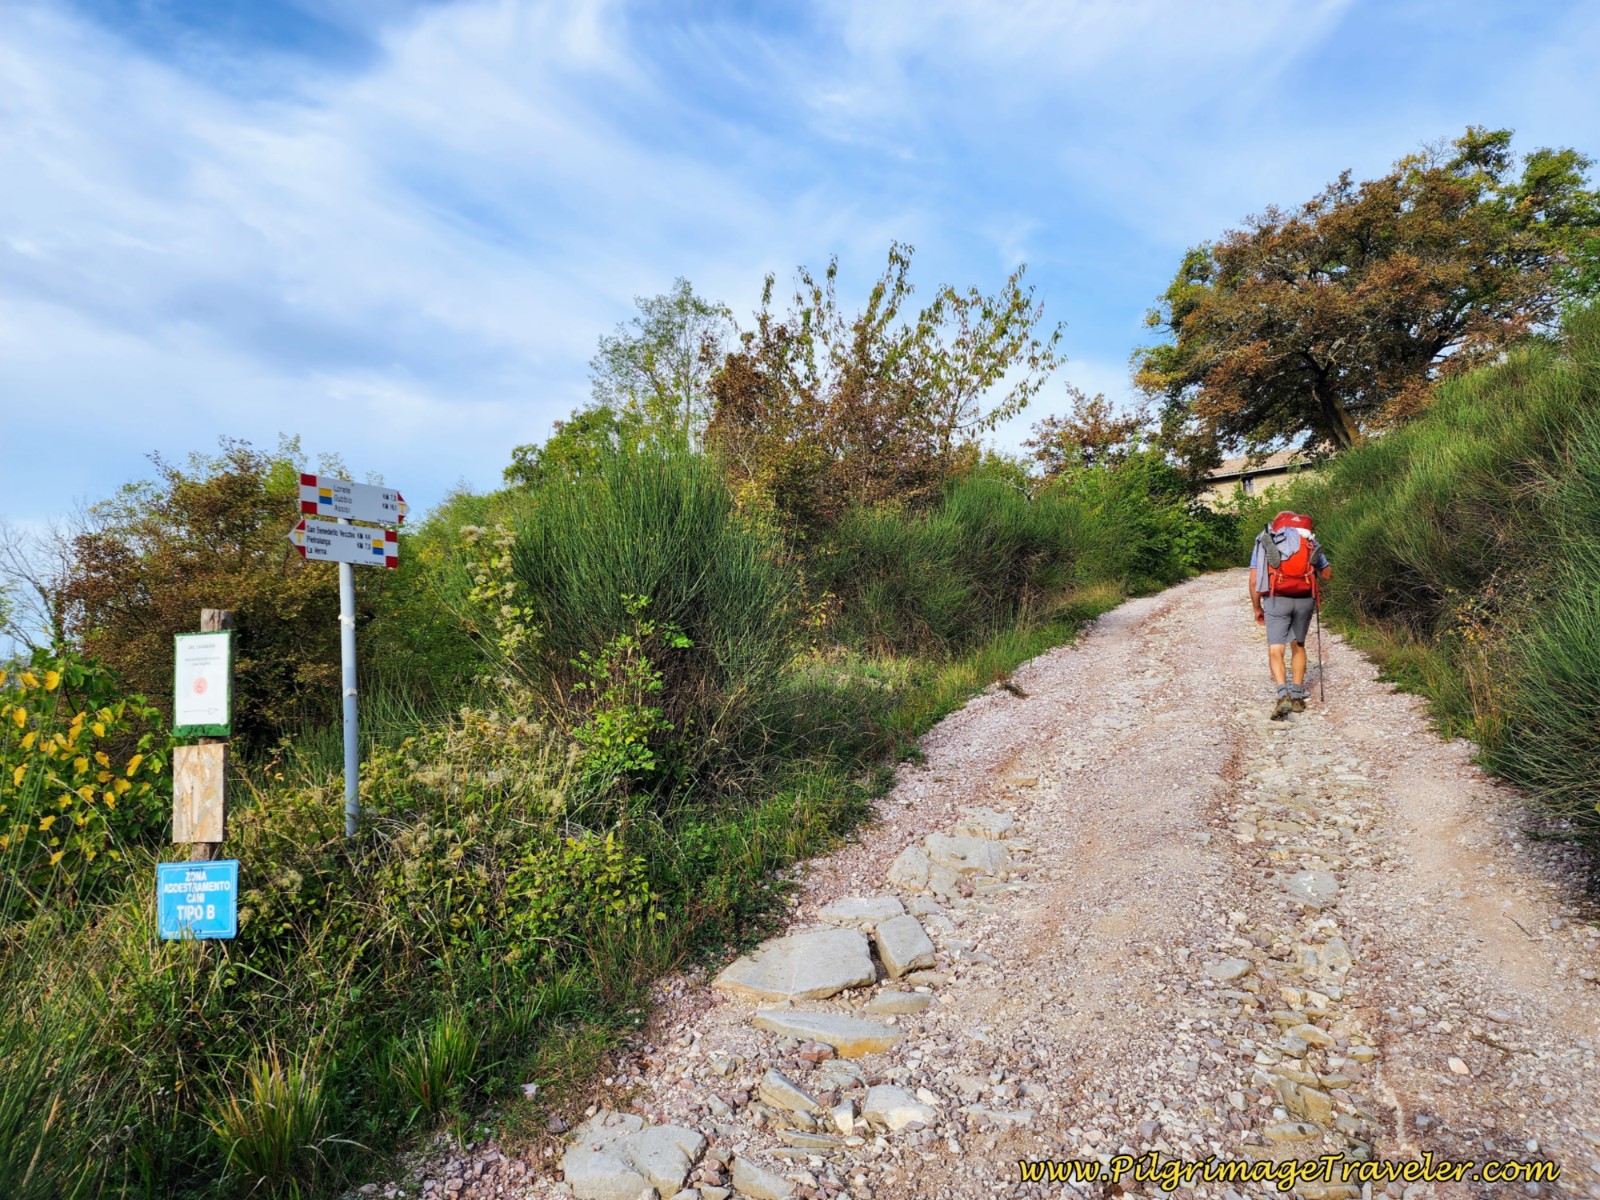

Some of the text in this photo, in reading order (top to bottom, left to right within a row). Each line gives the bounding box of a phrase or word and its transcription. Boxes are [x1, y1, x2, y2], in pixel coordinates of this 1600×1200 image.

[306, 525, 316, 534] San
[306, 546, 327, 555] La Verna
[185, 871, 207, 882] ZONA
[164, 881, 231, 893] ADDESTRAMENTO
[186, 893, 205, 903] CANI
[176, 904, 216, 921] TIPO B
